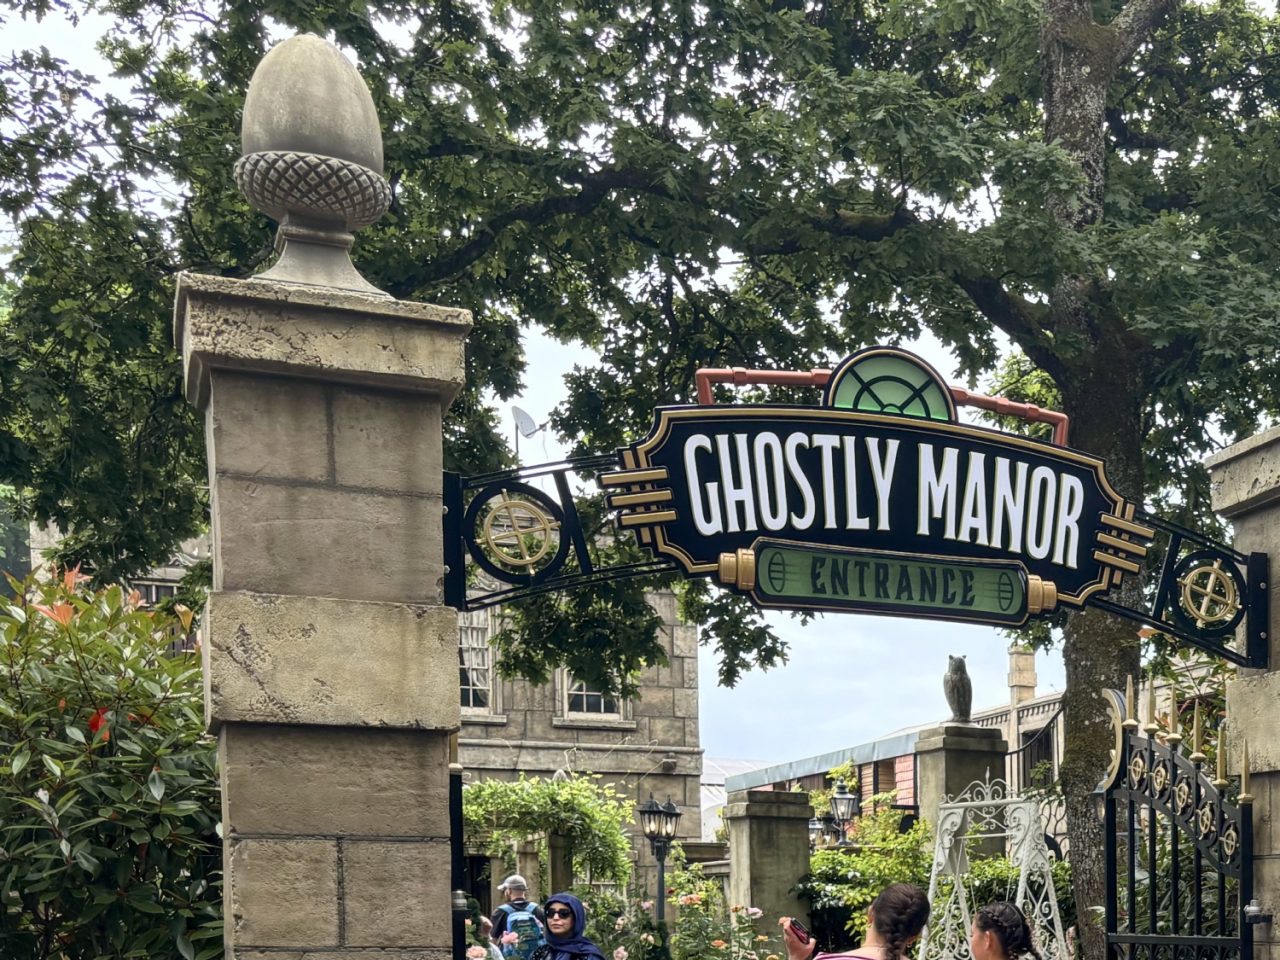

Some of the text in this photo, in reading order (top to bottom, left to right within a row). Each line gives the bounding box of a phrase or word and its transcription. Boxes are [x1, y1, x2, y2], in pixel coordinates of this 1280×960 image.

[683, 431, 1084, 569] GHOSTLY MANOR
[811, 556, 976, 607] ENTRANCE
